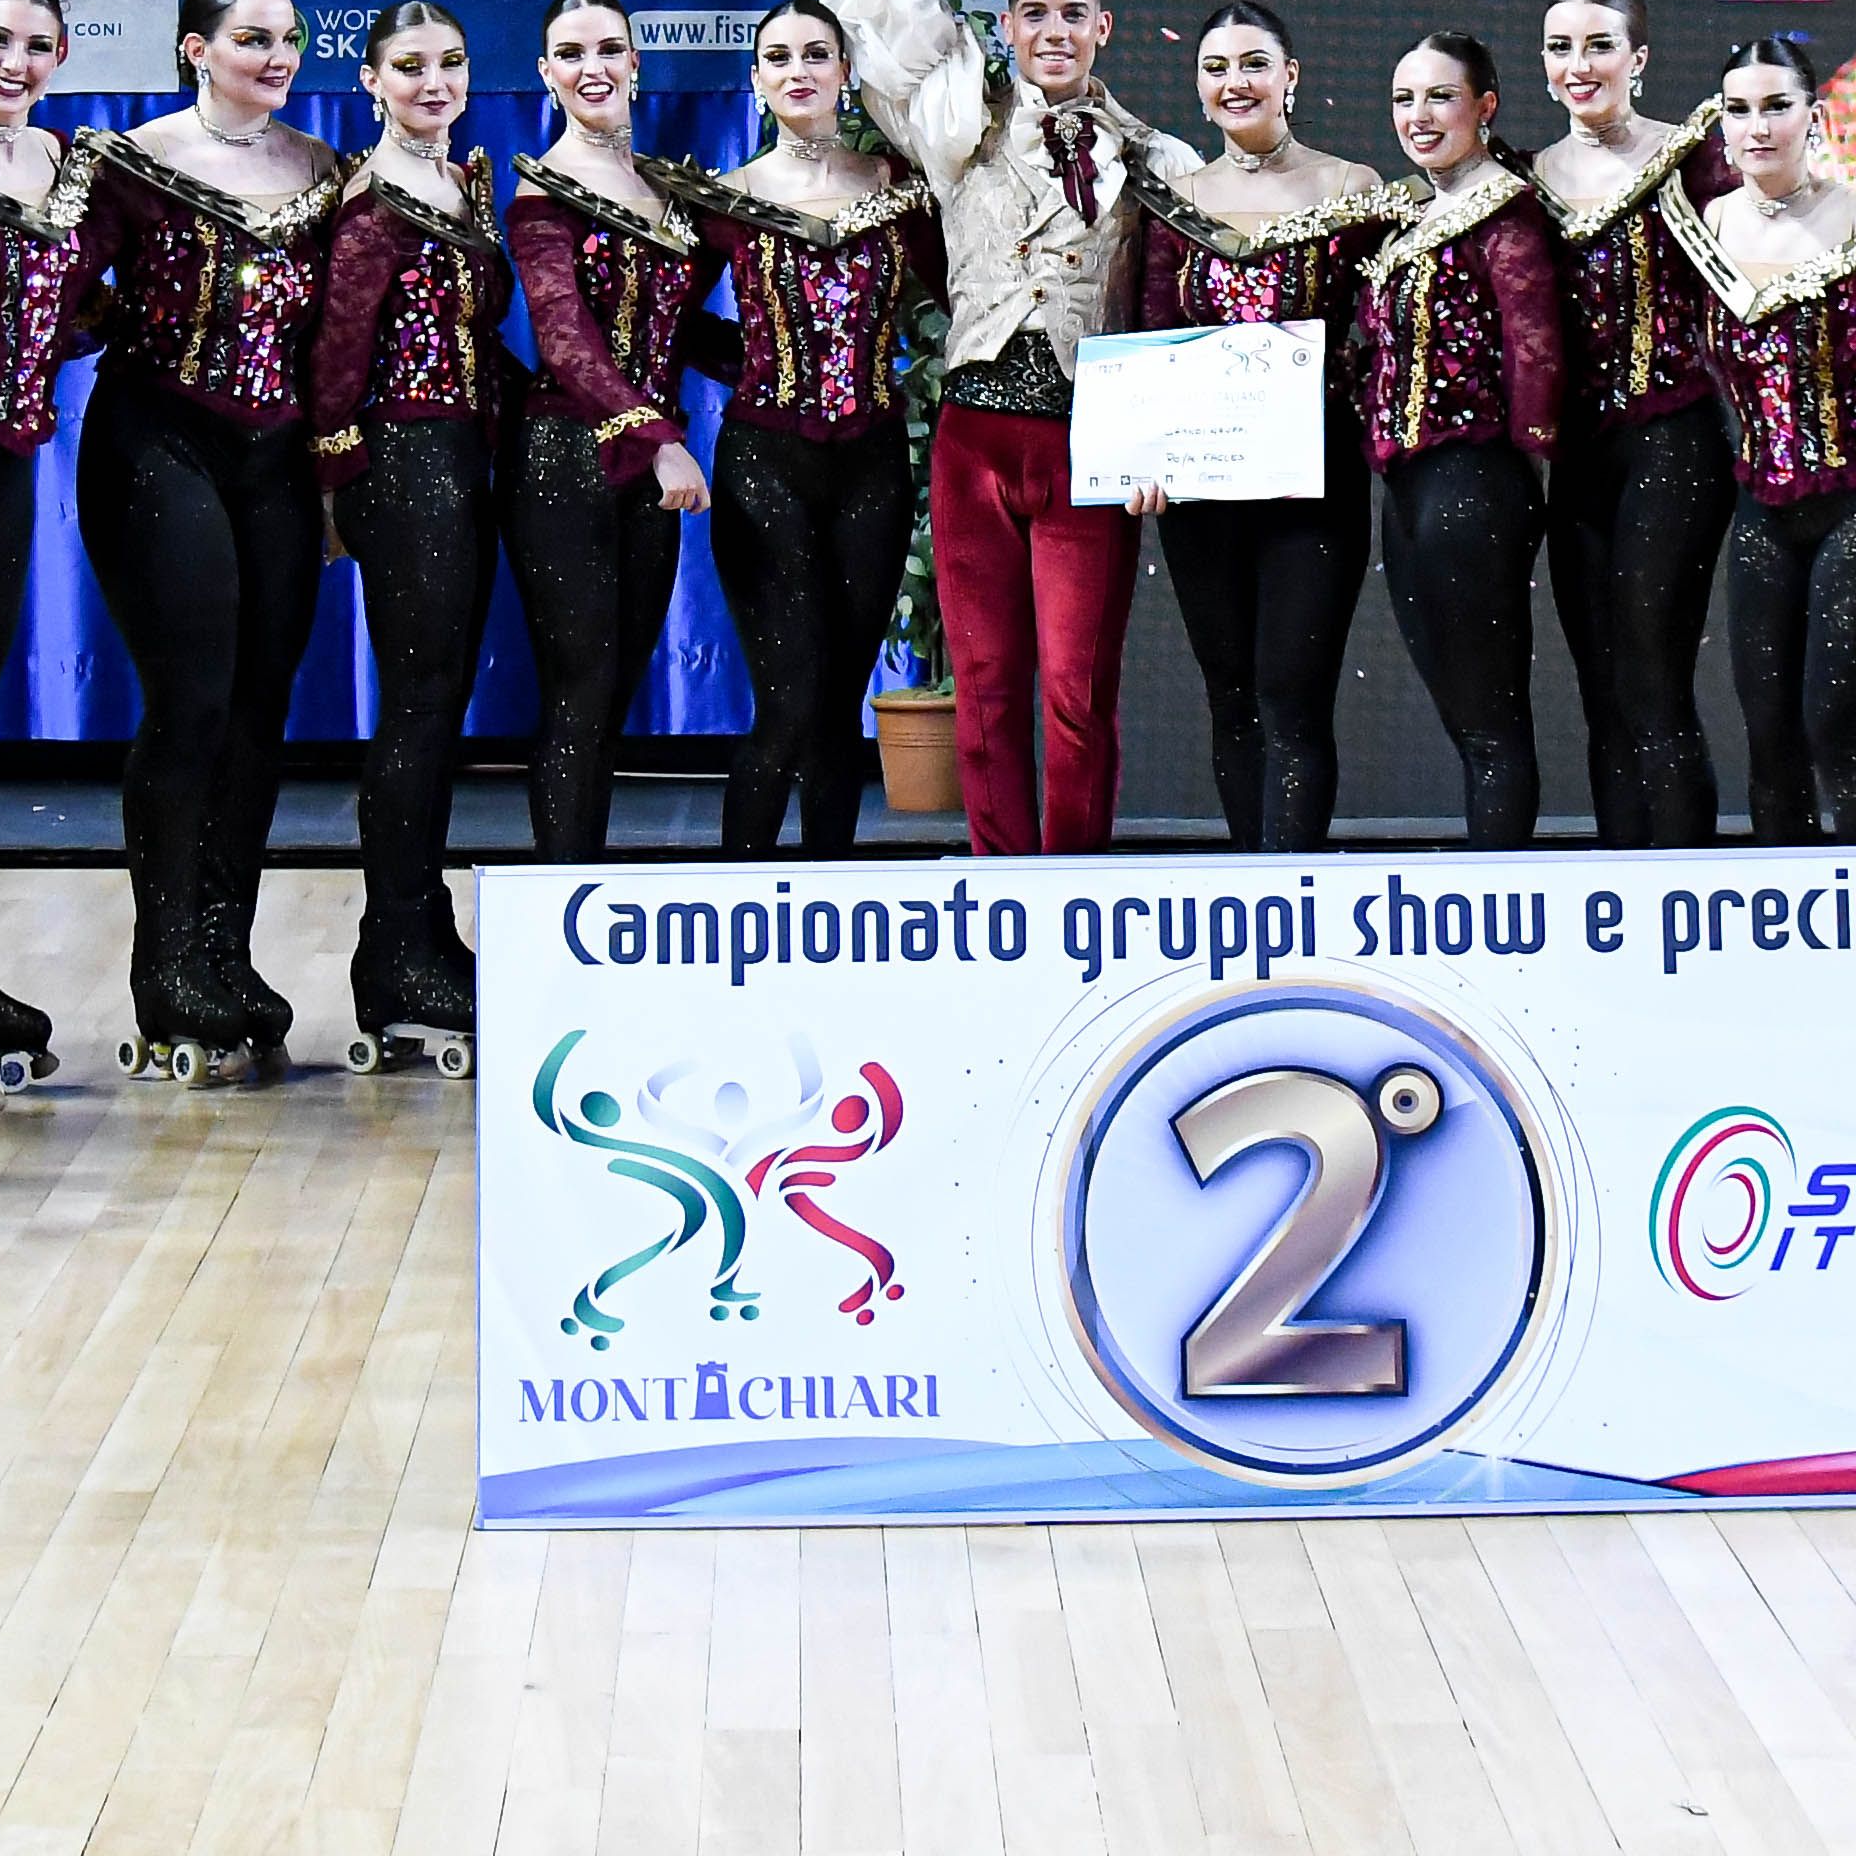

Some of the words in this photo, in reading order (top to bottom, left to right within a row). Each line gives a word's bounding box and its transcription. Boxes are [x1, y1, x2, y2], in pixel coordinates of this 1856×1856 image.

[74, 23, 122, 37] CONI
[639, 15, 758, 45] www.fisr
[563, 878, 1029, 986] Campionato
[1063, 875, 1316, 984] gruppi
[1352, 874, 1546, 957] show
[1585, 889, 1624, 953] e
